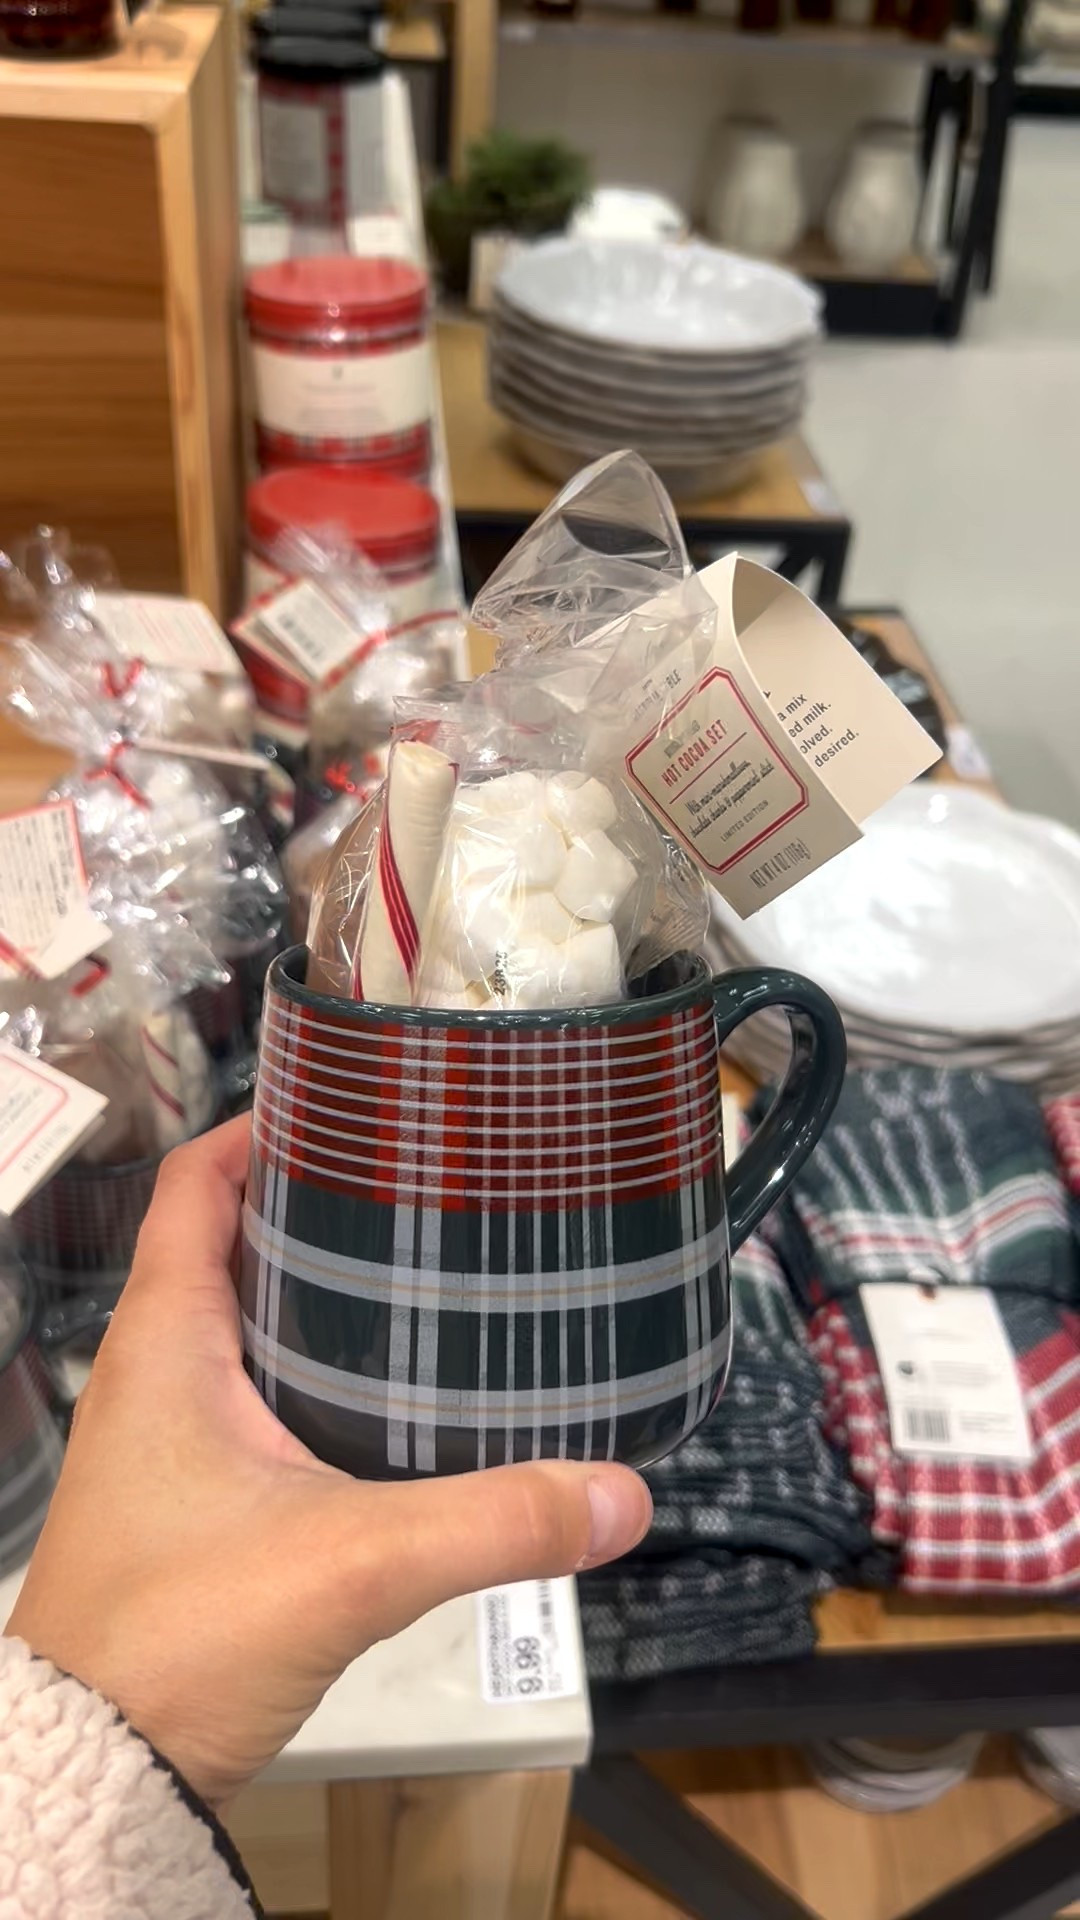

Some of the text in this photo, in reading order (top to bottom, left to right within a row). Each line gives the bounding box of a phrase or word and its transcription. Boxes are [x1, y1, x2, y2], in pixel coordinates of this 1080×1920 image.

[777, 711, 787, 721] a
[785, 694, 807, 714] mix
[802, 703, 831, 725] milk.
[661, 764, 682, 787] HOT
[678, 737, 710, 771] COCOA
[705, 719, 727, 744] SET
[814, 728, 859, 767] desired.
[720, 799, 769, 842] LIMITED EDITION
[749, 869, 768, 888] NET
[760, 862, 778, 881] WT
[513, 1635, 543, 1694] 9.99
